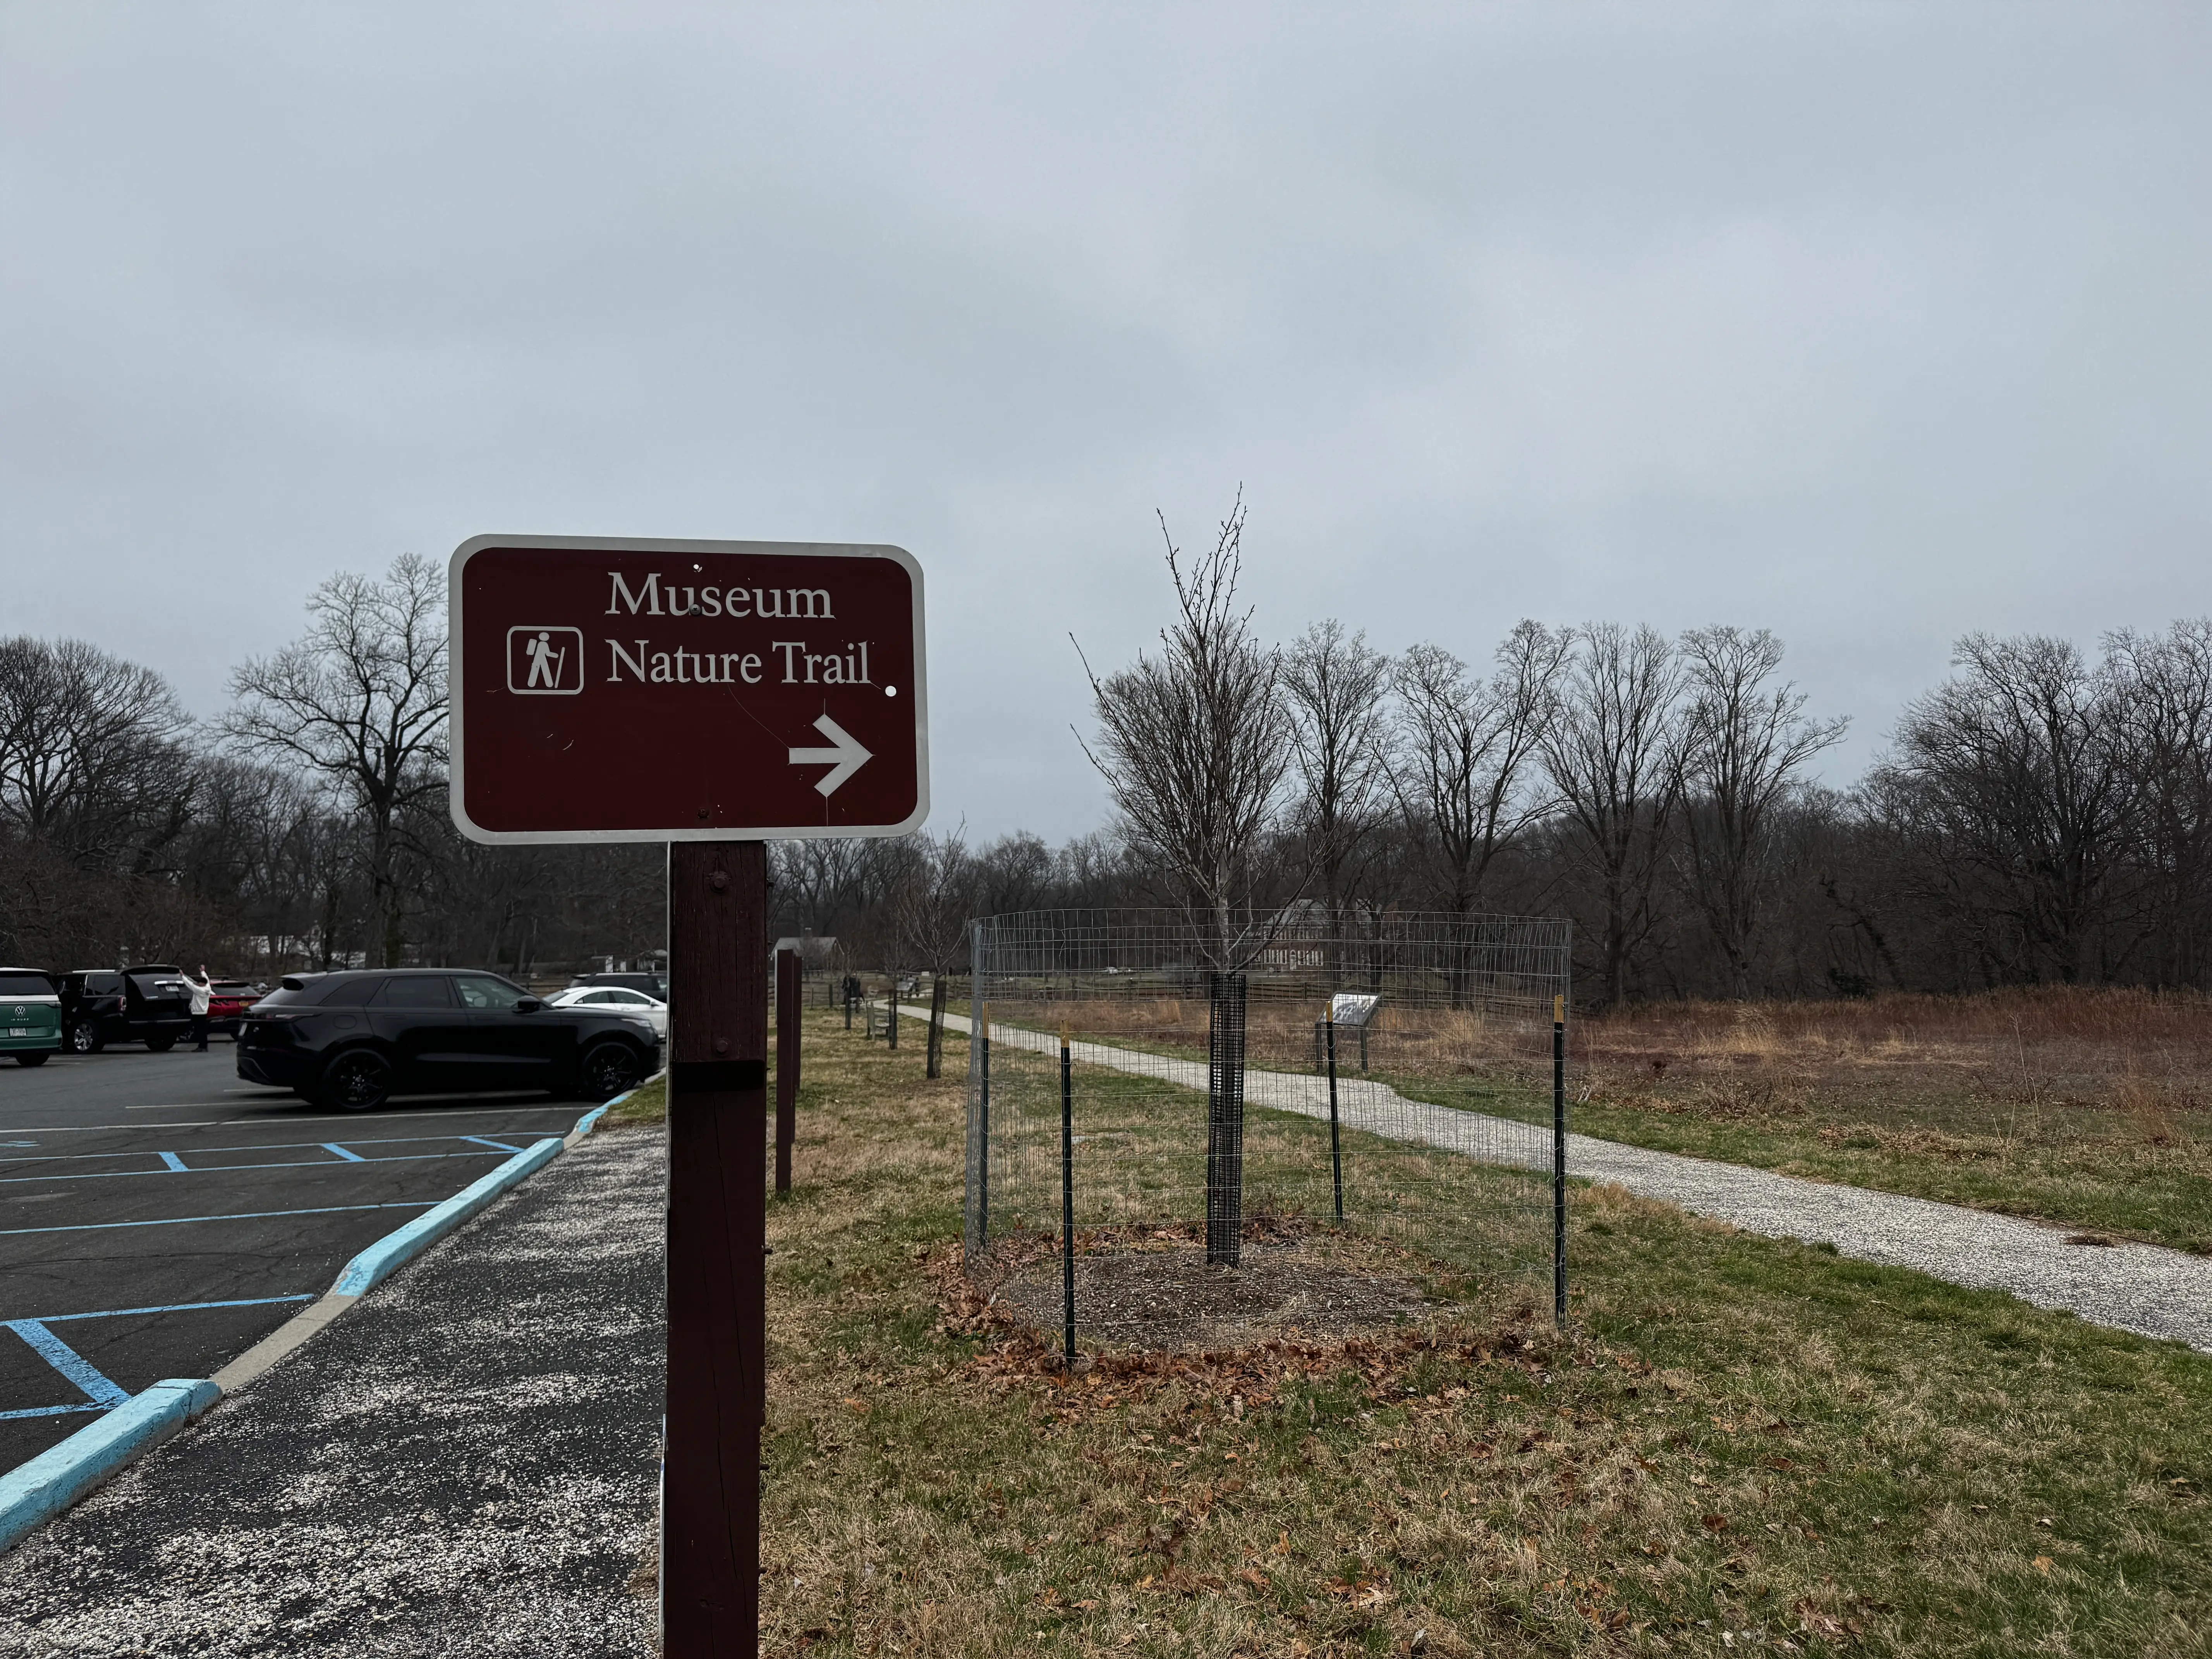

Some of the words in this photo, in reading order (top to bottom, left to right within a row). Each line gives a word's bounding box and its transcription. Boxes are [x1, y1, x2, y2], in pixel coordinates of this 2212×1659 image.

[605, 572, 836, 620] Museum
[605, 639, 763, 684] Nature
[772, 641, 871, 684] Trail
